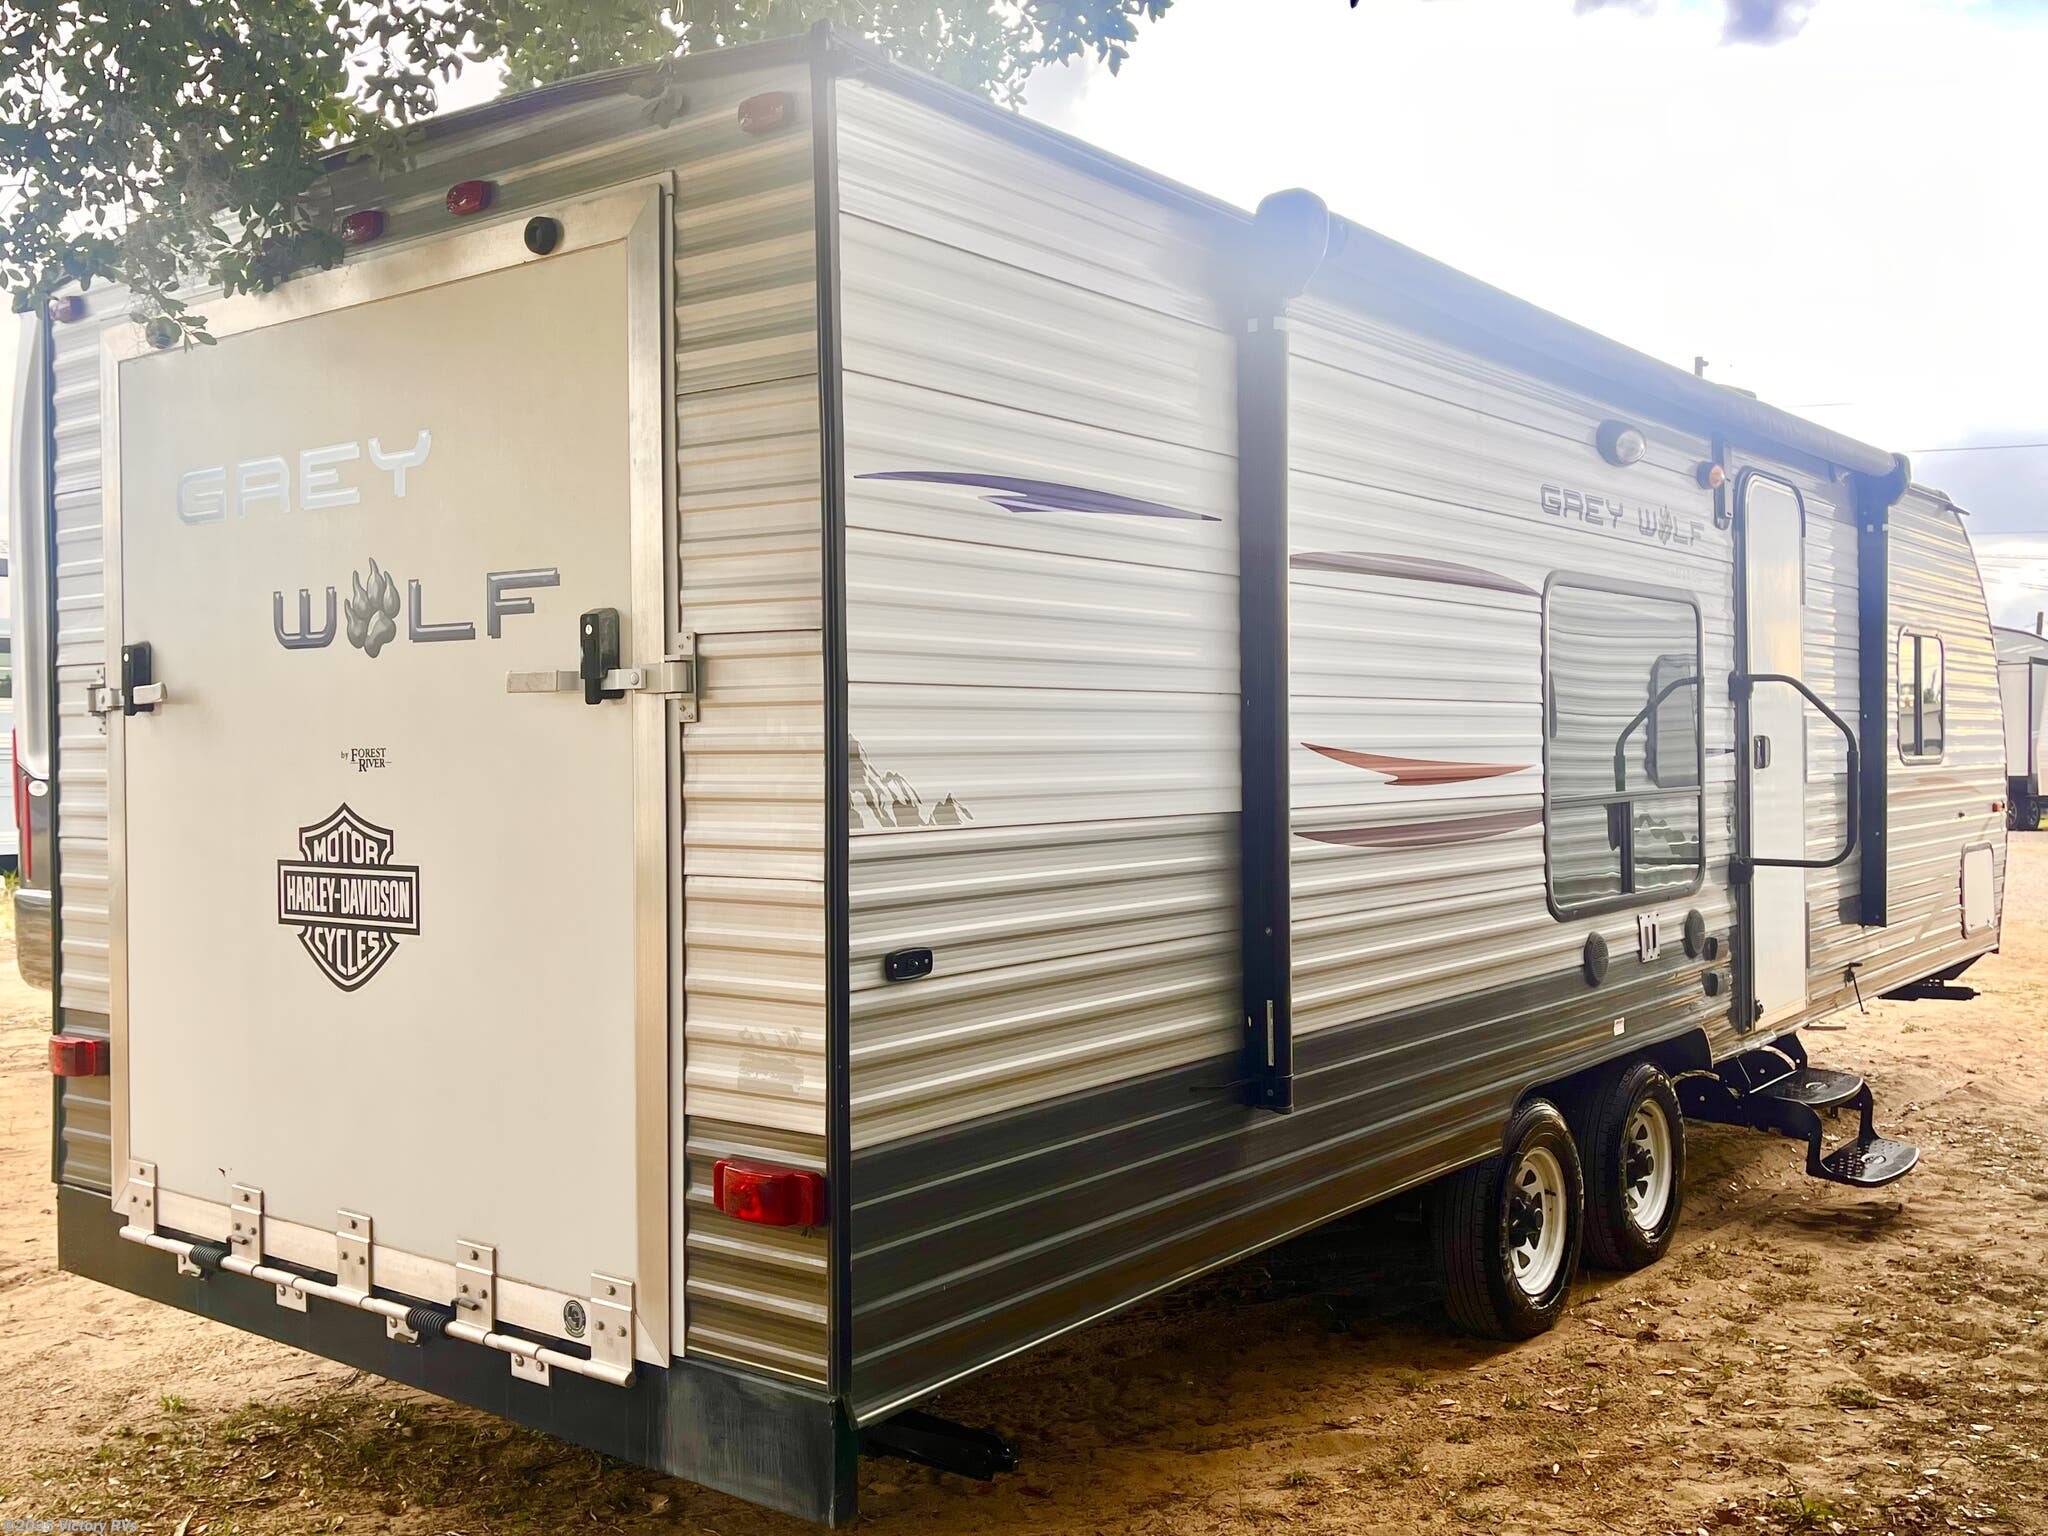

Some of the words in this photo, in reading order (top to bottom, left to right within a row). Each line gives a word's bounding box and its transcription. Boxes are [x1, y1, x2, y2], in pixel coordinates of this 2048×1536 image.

[176, 429, 432, 525] GREY
[1540, 483, 1624, 529] GREY
[273, 557, 560, 658] WOLF
[340, 751, 349, 761] by
[351, 747, 387, 762] FOREST
[358, 758, 386, 772] RIVER
[313, 821, 379, 865] MOTOR
[286, 875, 410, 919] HARLEY-DAVIDSON
[314, 926, 380, 976] CYCLES
